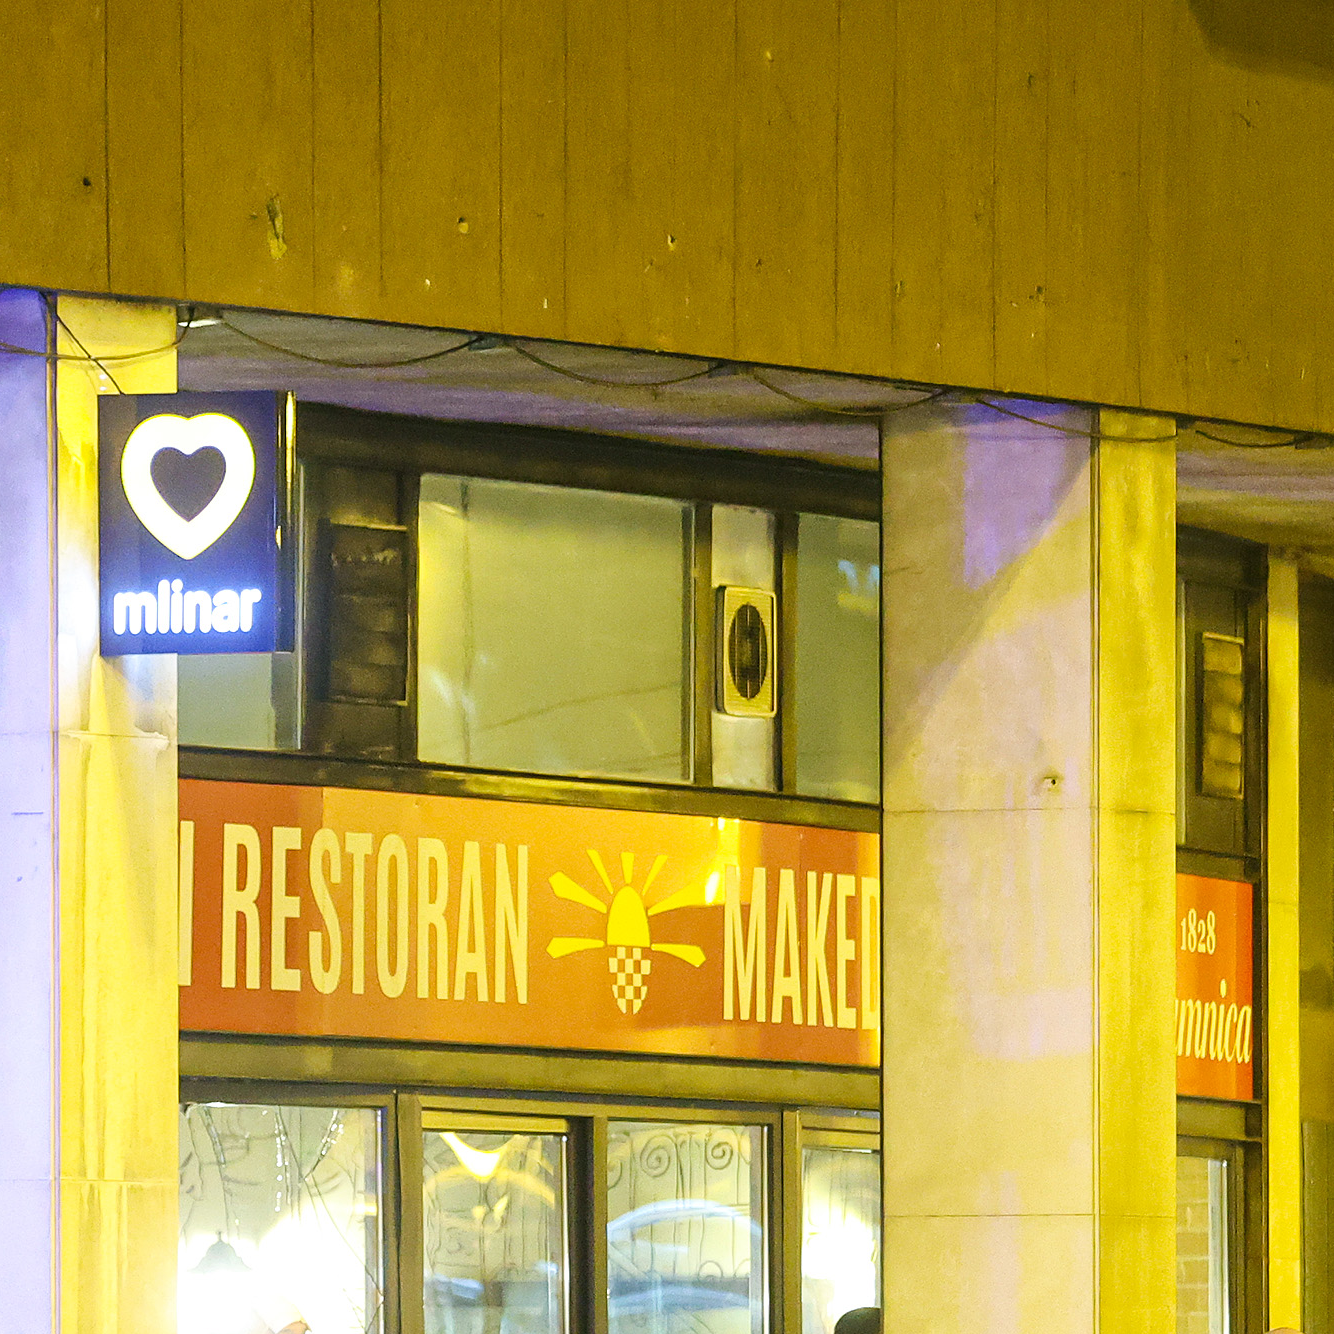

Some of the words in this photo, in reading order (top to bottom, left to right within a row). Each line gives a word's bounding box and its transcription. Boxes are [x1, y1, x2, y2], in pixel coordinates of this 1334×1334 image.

[113, 578, 263, 635] mlinar
[220, 821, 530, 1005] RESTORAN
[722, 862, 880, 1031] MAKED
[1179, 907, 1217, 956] 1828
[1175, 977, 1254, 1064] mnica
